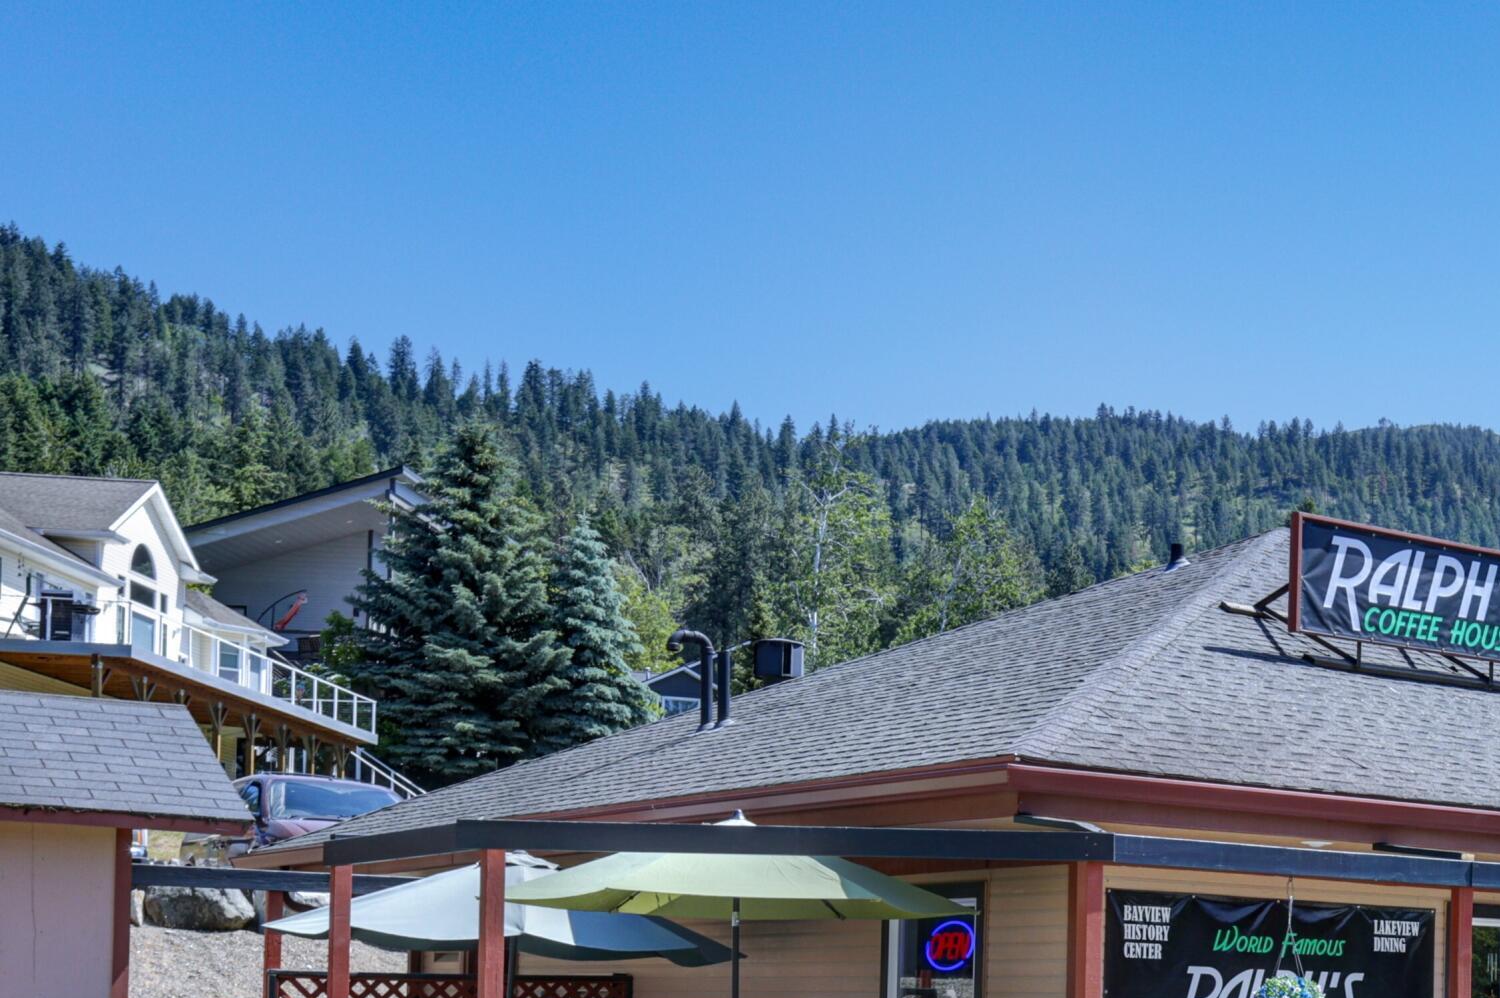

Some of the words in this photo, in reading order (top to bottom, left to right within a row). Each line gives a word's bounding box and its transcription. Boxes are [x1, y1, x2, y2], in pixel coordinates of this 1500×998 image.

[1364, 607, 1442, 642] COFFEE
[1123, 904, 1172, 924] BAYVIEW
[1123, 924, 1170, 942] HISTORY
[1373, 919, 1420, 937] LAKEVIEW
[930, 932, 970, 960] OPEN
[1213, 925, 1274, 954] WORLD
[1281, 932, 1346, 958] FAMOUS
[1373, 937, 1407, 953] DINING
[1123, 943, 1163, 960] CENTER
